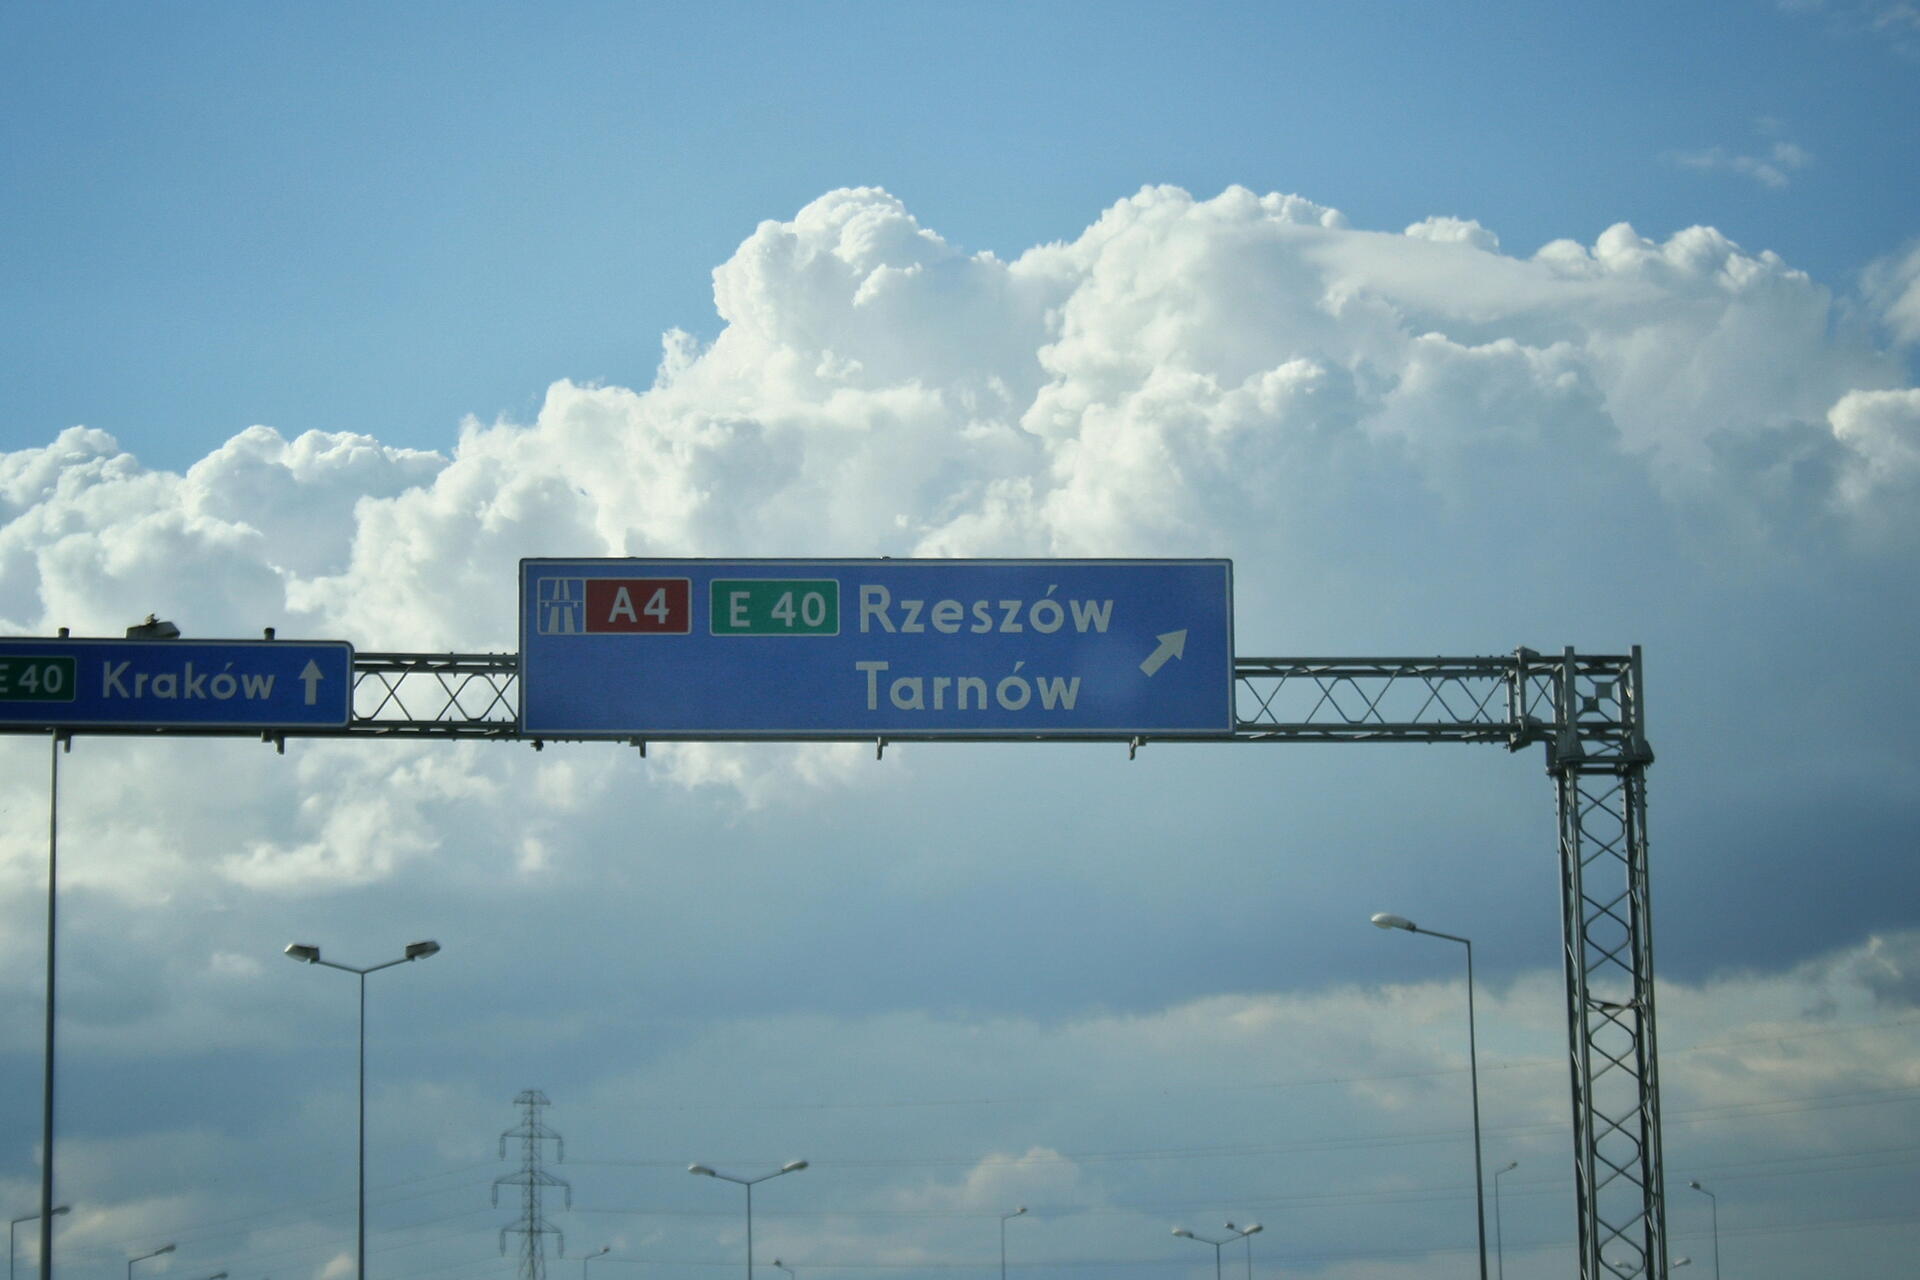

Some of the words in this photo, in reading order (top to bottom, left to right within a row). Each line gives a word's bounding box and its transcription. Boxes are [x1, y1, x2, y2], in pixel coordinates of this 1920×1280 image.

[608, 586, 670, 624] A4
[729, 591, 751, 627] E
[771, 591, 826, 627] 40
[859, 584, 1114, 634] Rzeszów
[17, 664, 63, 694] 40
[102, 660, 275, 699] Kraków
[855, 661, 1081, 711] Tarnów
